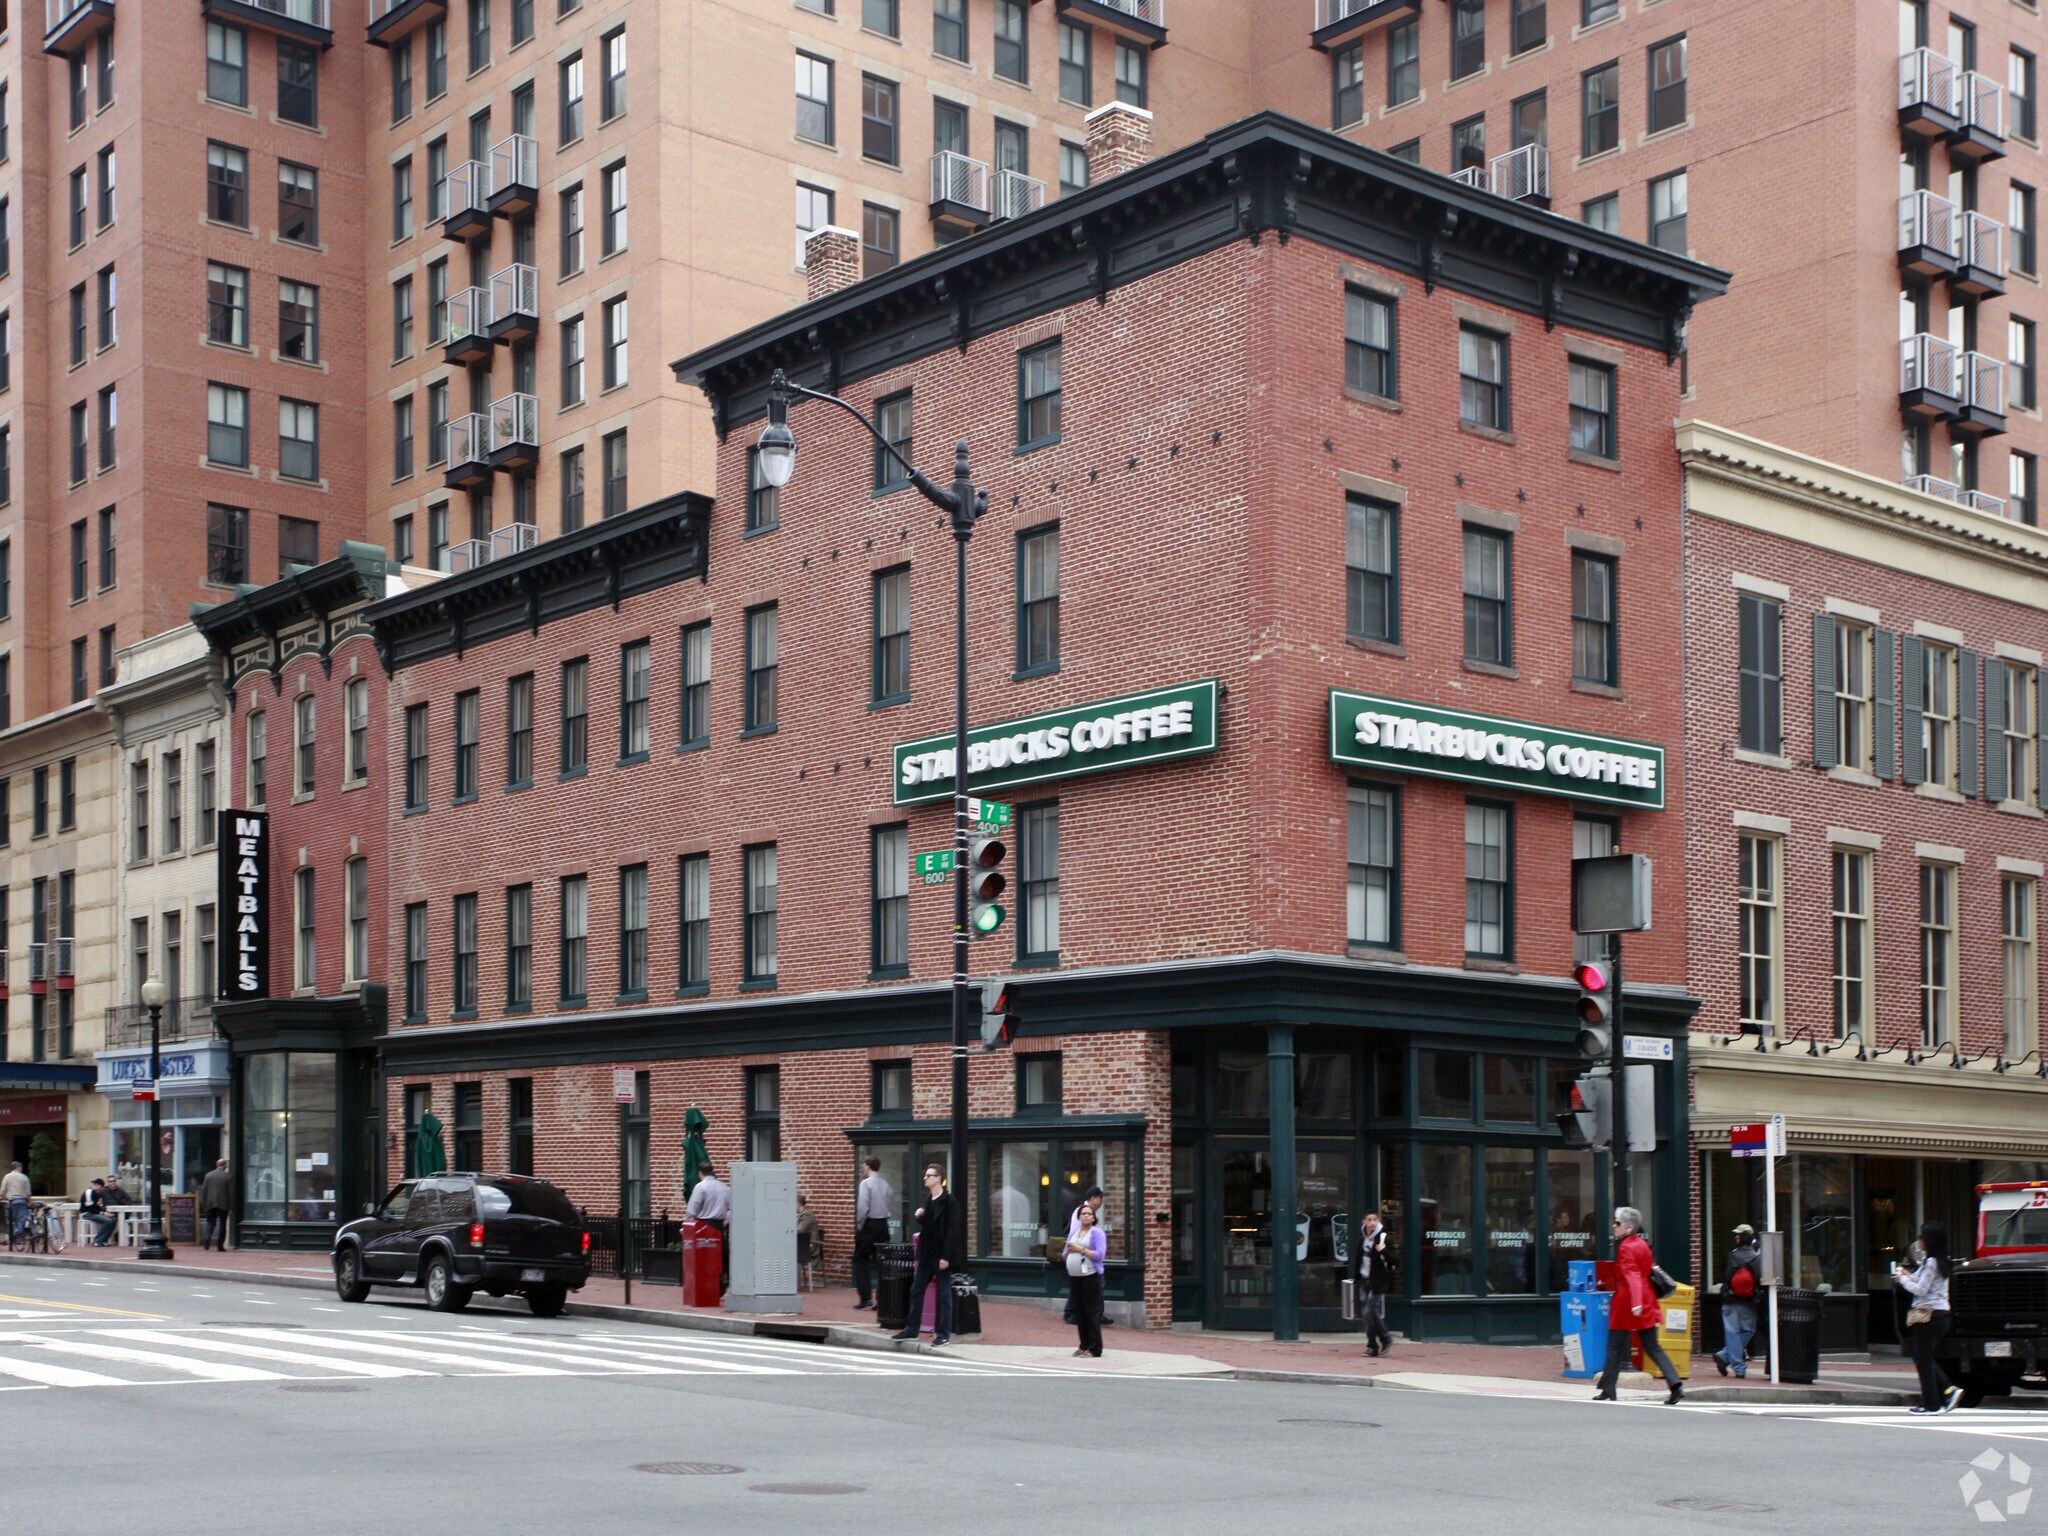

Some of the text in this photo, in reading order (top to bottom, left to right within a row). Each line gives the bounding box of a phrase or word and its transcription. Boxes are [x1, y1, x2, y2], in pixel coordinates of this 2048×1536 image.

[1071, 701, 1193, 753] COFFEE
[1355, 711, 1657, 789] STARBUCKS COFFEE
[986, 804, 995, 820] 7
[977, 821, 1000, 834] 400
[925, 855, 934, 871] E
[925, 872, 945, 884] 600
[235, 817, 261, 991] MEATBALLS
[1425, 1231, 1466, 1239] STARBUCKS
[1491, 1231, 1530, 1239] STARBUCKS
[1553, 1232, 1590, 1240] STARBUCKS
[1433, 1239, 1459, 1247] COFFEE
